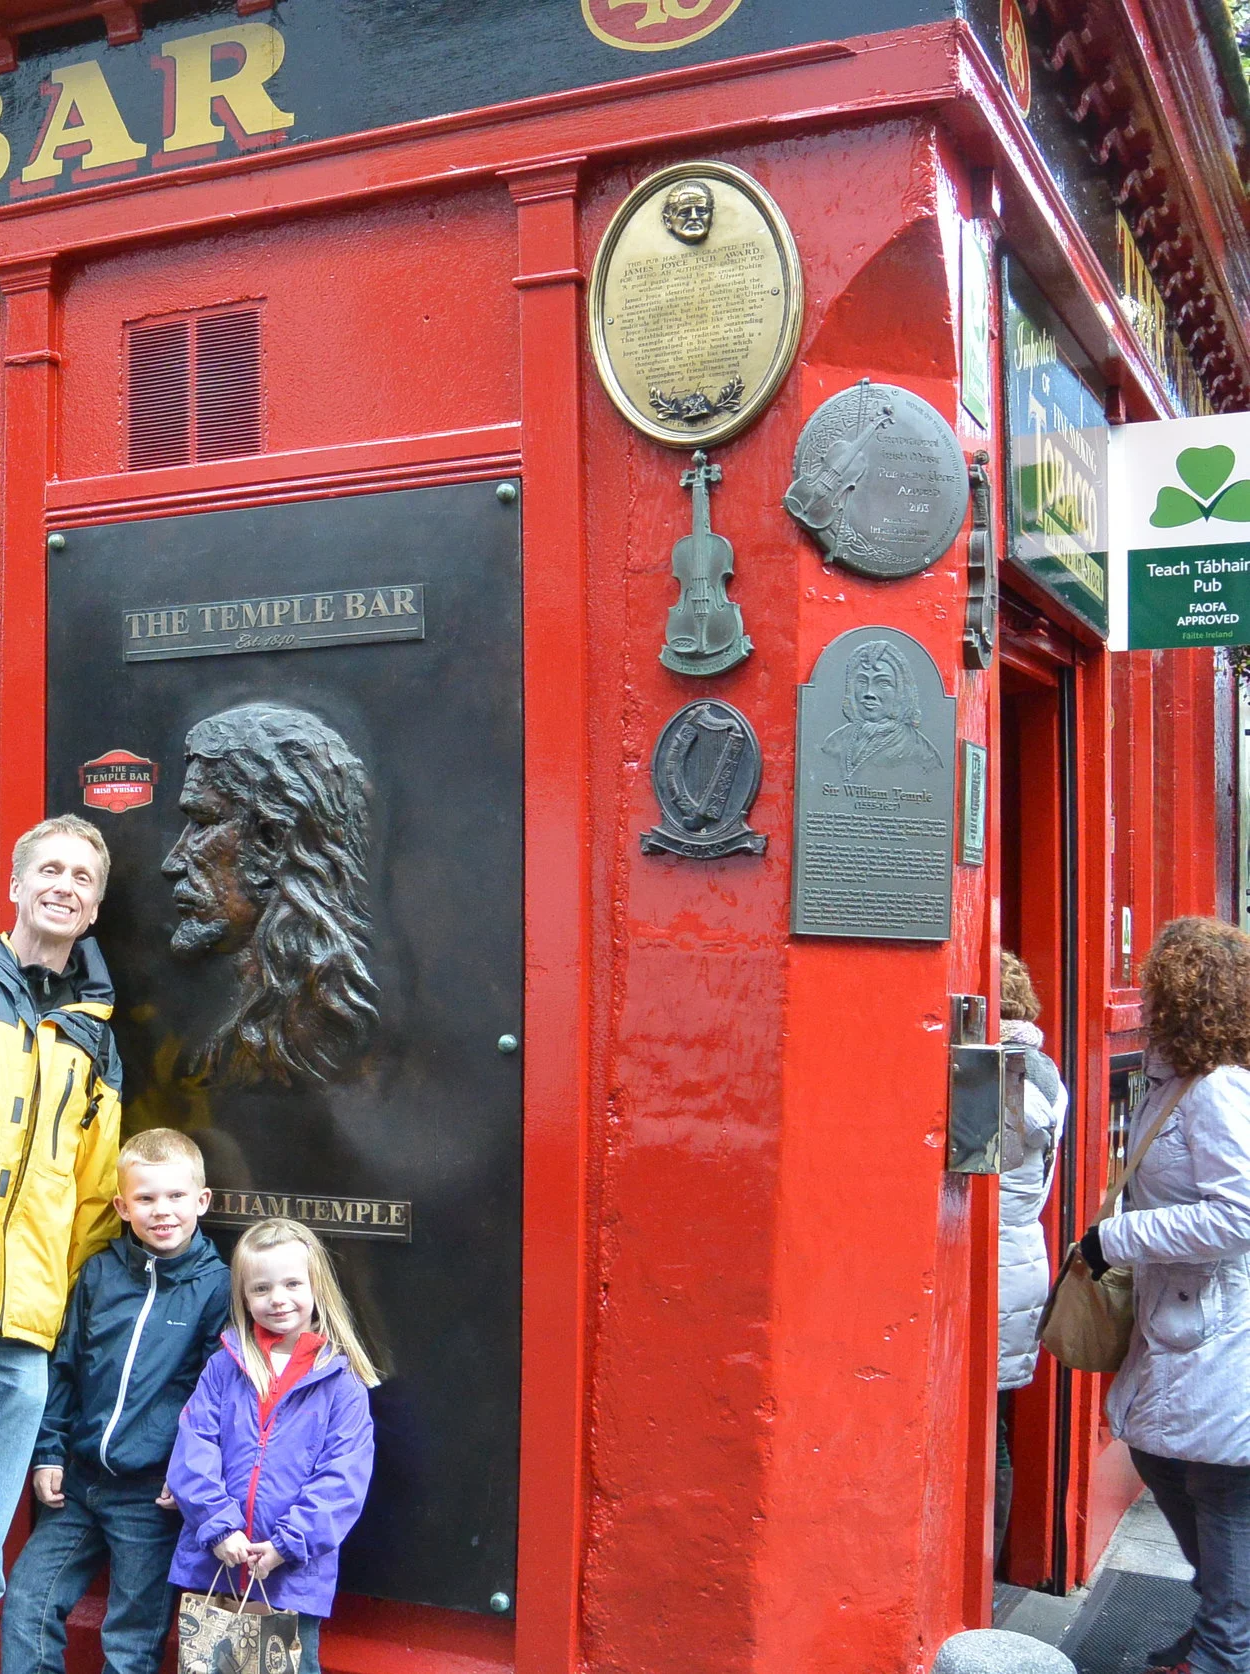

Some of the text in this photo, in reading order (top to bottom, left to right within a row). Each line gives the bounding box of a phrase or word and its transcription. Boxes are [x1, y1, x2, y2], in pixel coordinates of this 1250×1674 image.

[623, 247, 760, 277] JAMES JOYCE PUB AWARD
[1146, 561, 1190, 577] Teach
[1194, 578, 1222, 593] Pub
[125, 588, 418, 640] THE TEMPLE BAR
[1189, 602, 1227, 613] FAOFA
[1177, 614, 1239, 626] APPROVED
[1206, 630, 1233, 638] Ireland
[109, 765, 127, 774] THE
[85, 772, 151, 784] TEMPLE BAR
[112, 786, 143, 794] WHISKEY
[822, 783, 933, 804] Sir William Temple
[209, 1192, 406, 1226] LLIAM TEMPLE
